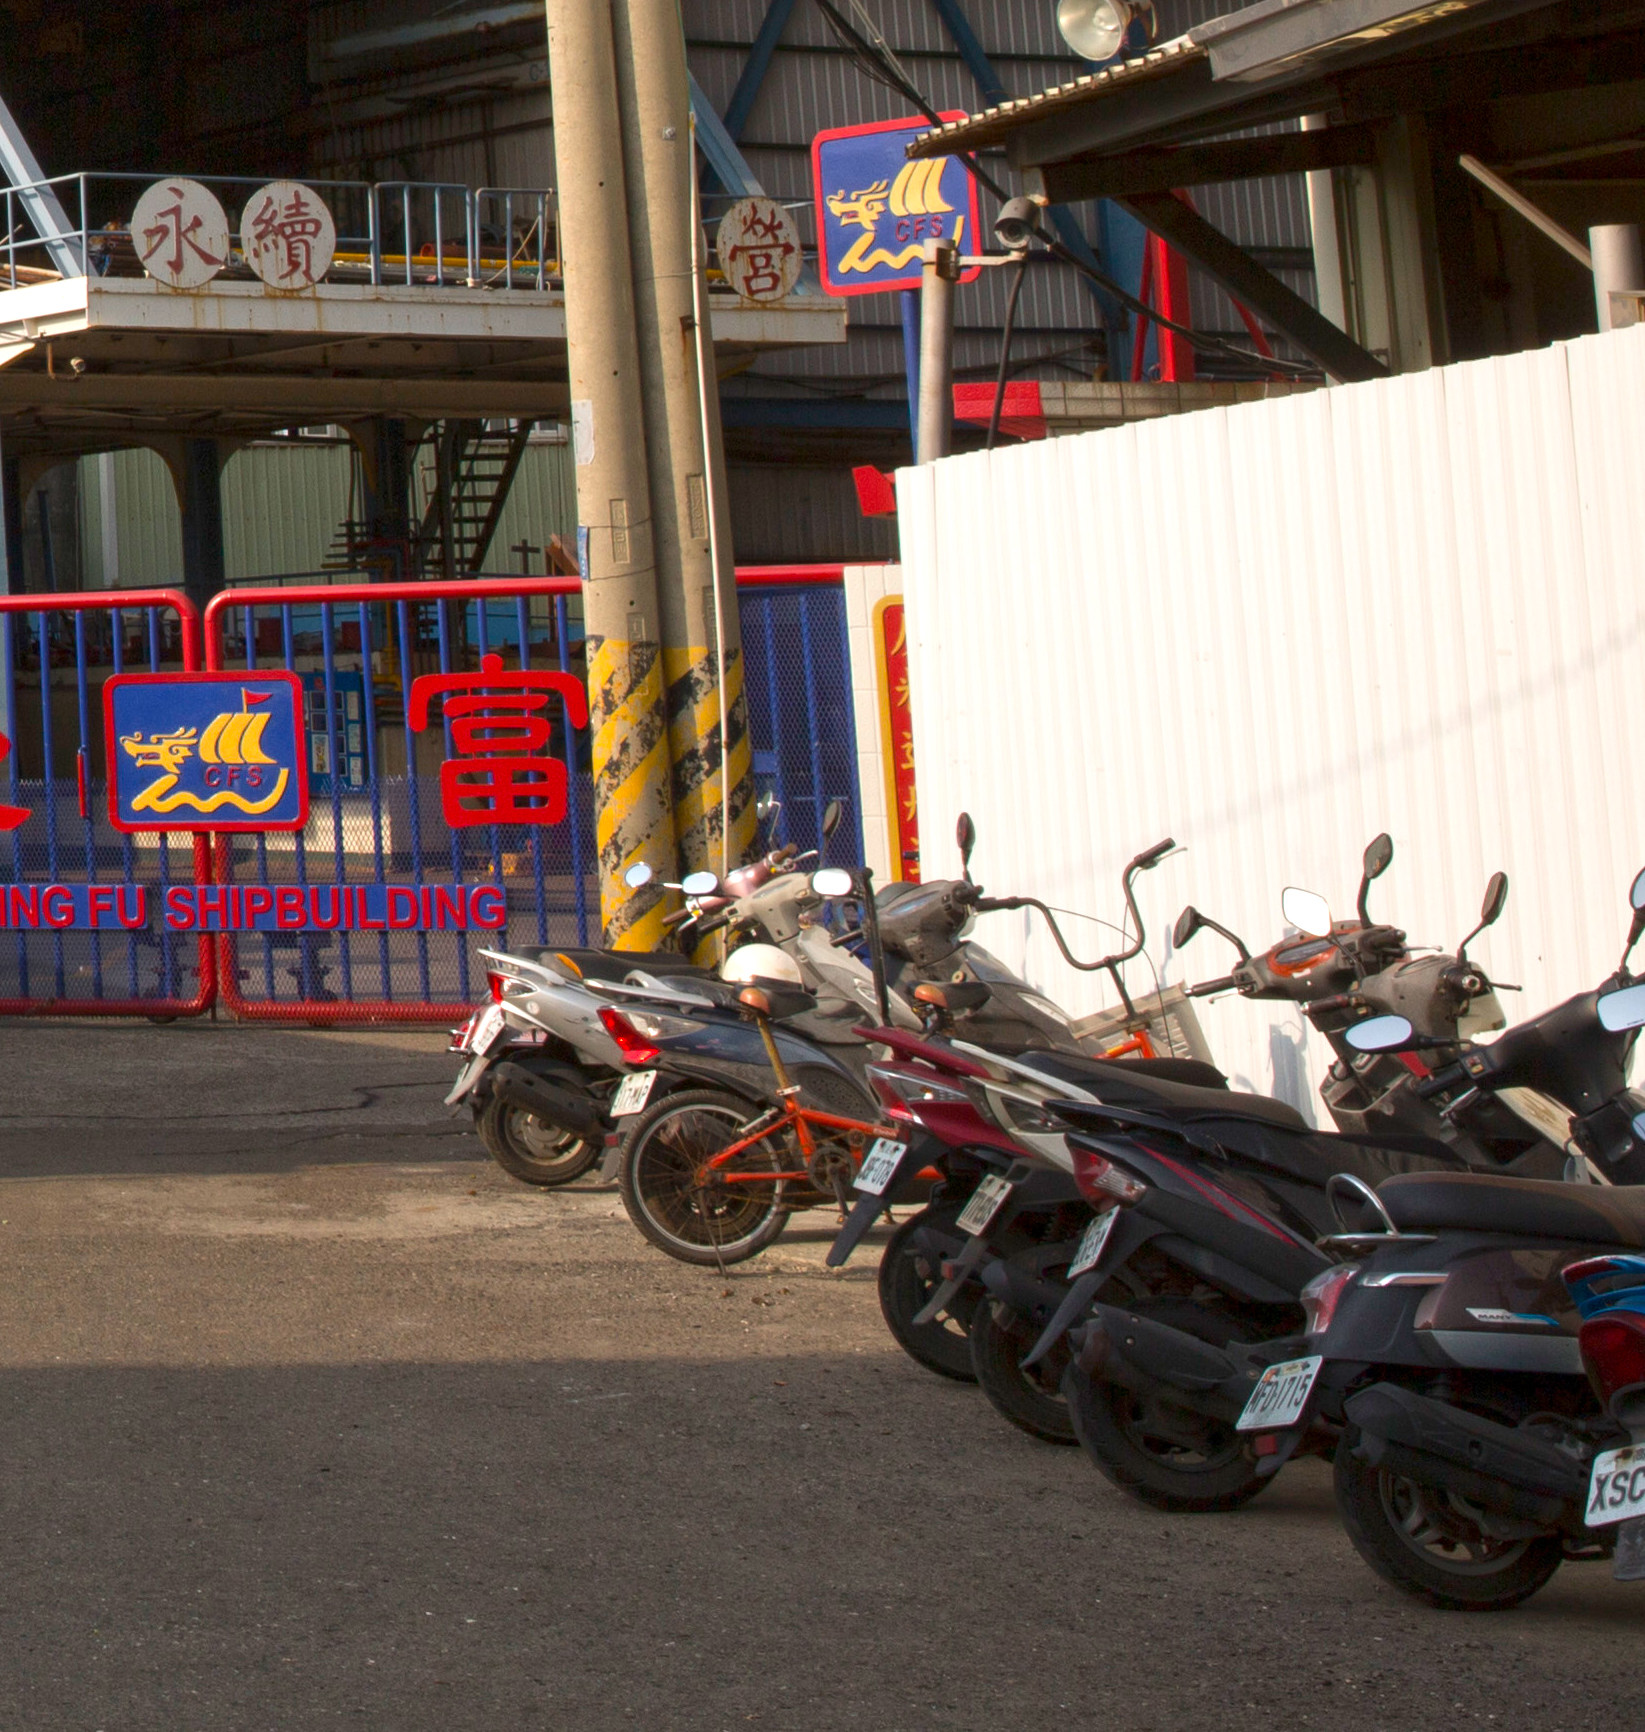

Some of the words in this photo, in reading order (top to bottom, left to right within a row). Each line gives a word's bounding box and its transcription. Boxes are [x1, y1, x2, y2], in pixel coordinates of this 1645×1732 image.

[728, 201, 795, 297] 營
[895, 215, 943, 242] CFS
[410, 653, 589, 828] 富
[204, 766, 263, 787] CFS
[87, 885, 147, 929] FU
[165, 885, 506, 931] SHIPBUILDING
